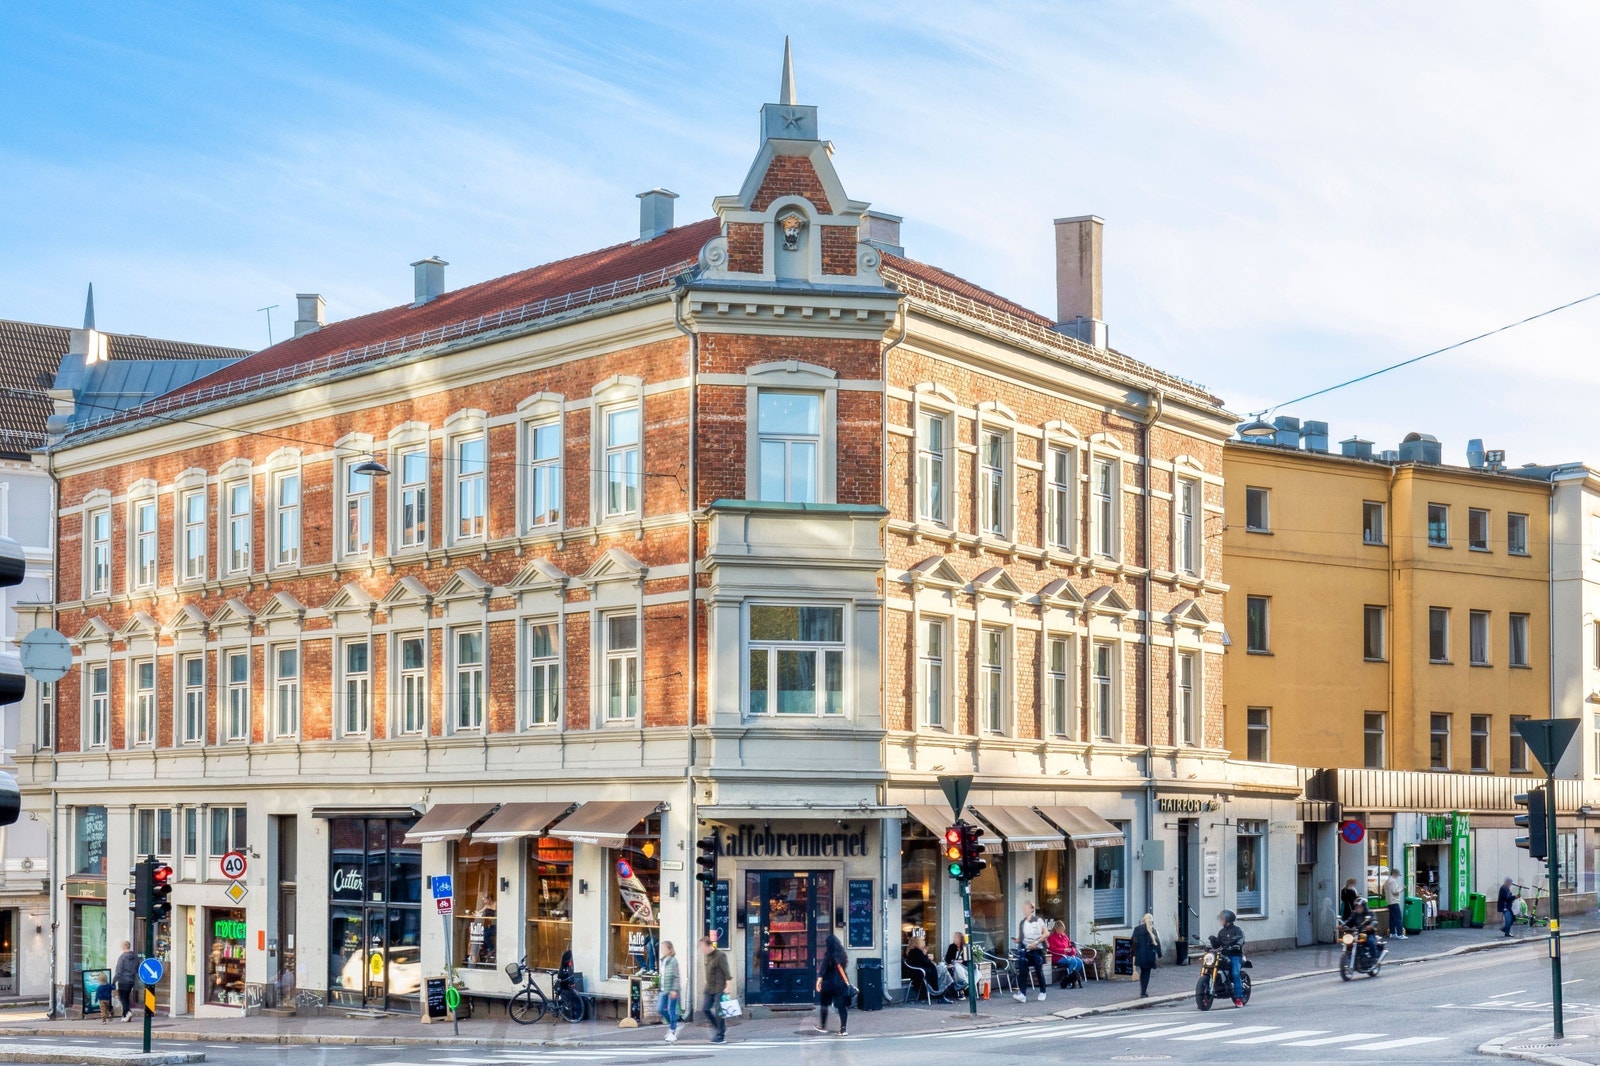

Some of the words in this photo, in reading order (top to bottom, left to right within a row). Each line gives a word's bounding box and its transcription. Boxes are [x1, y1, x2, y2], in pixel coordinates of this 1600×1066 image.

[1160, 799, 1201, 812] HAIRPORT
[1456, 816, 1470, 836] 7-23
[712, 824, 869, 857] Kaffebrenneriet
[226, 858, 242, 872] 40
[628, 931, 645, 944] Kaffe
